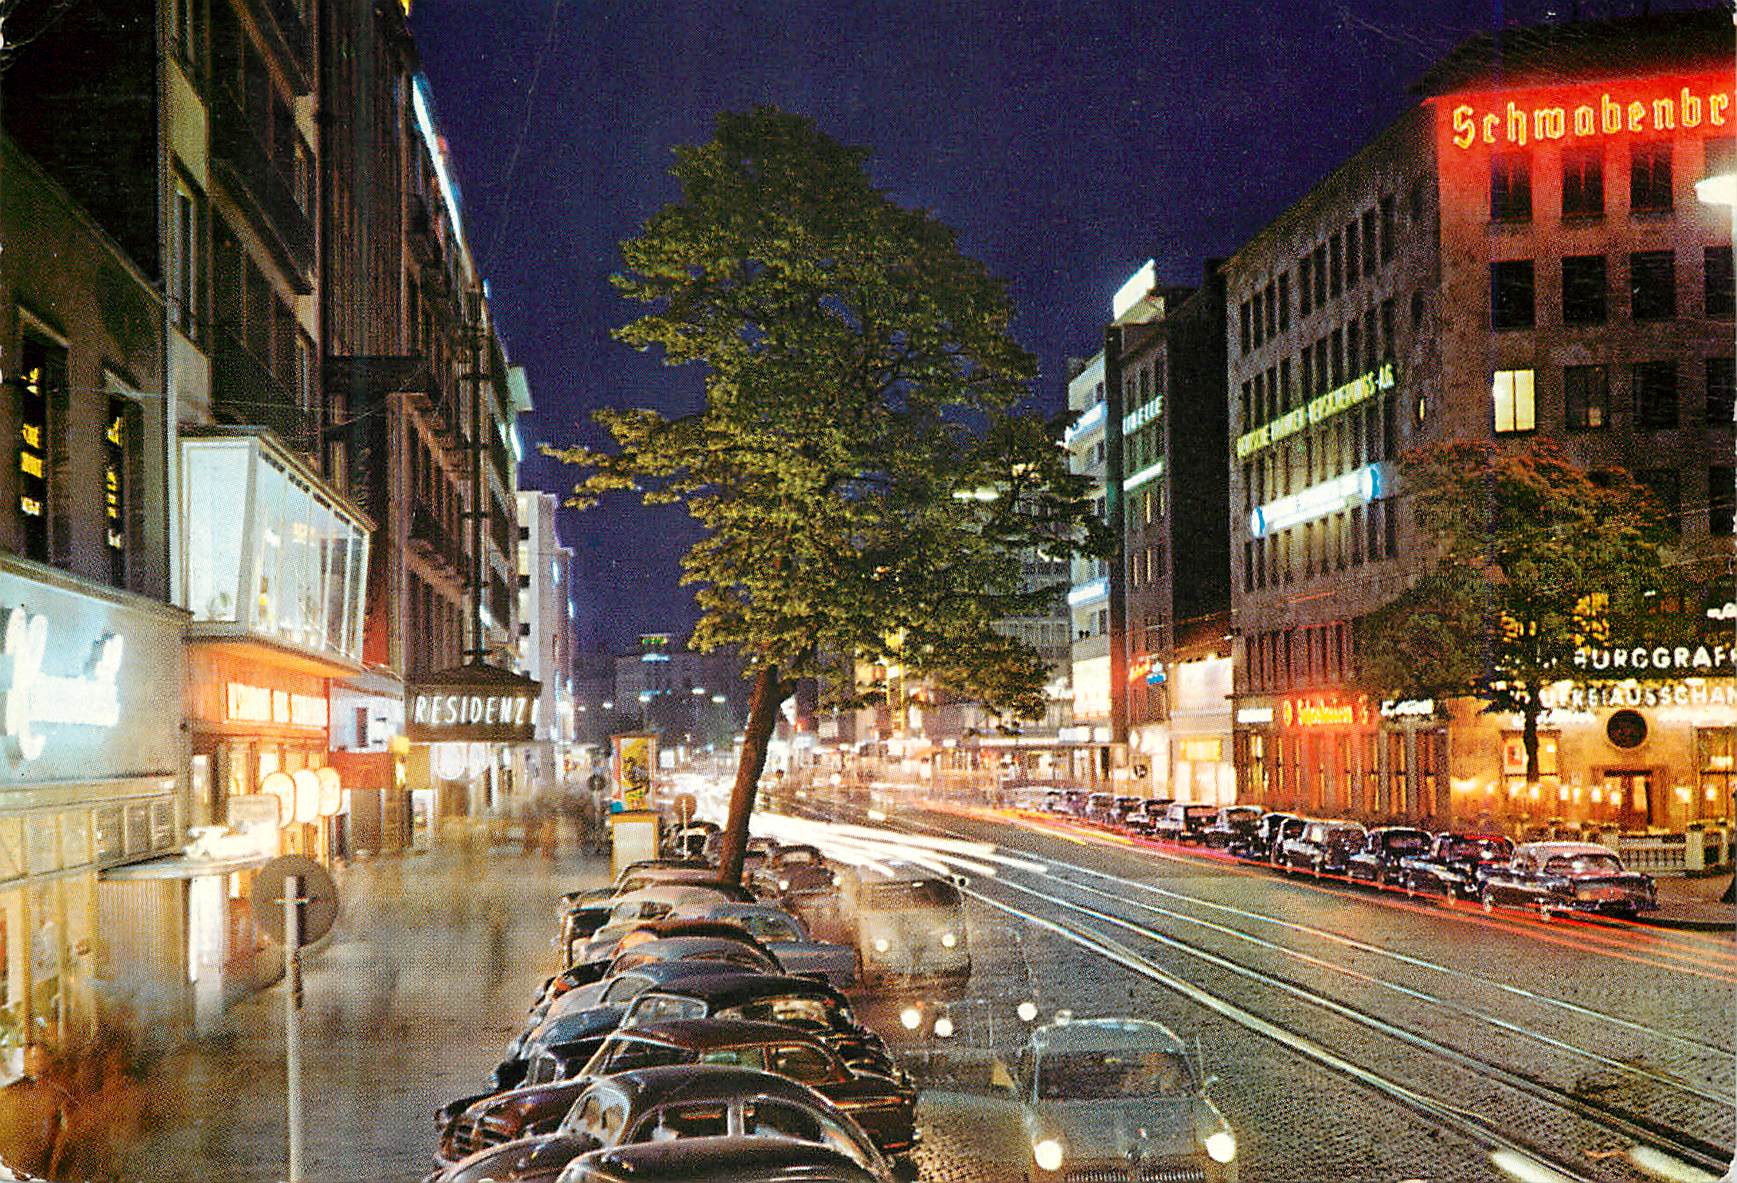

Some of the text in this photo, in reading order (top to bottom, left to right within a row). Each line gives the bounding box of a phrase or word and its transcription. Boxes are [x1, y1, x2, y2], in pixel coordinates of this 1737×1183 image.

[1452, 87, 1729, 149] Schwabenbr
[1573, 646, 1735, 669] BURGGRAF
[415, 694, 527, 724] RESIDENZ
